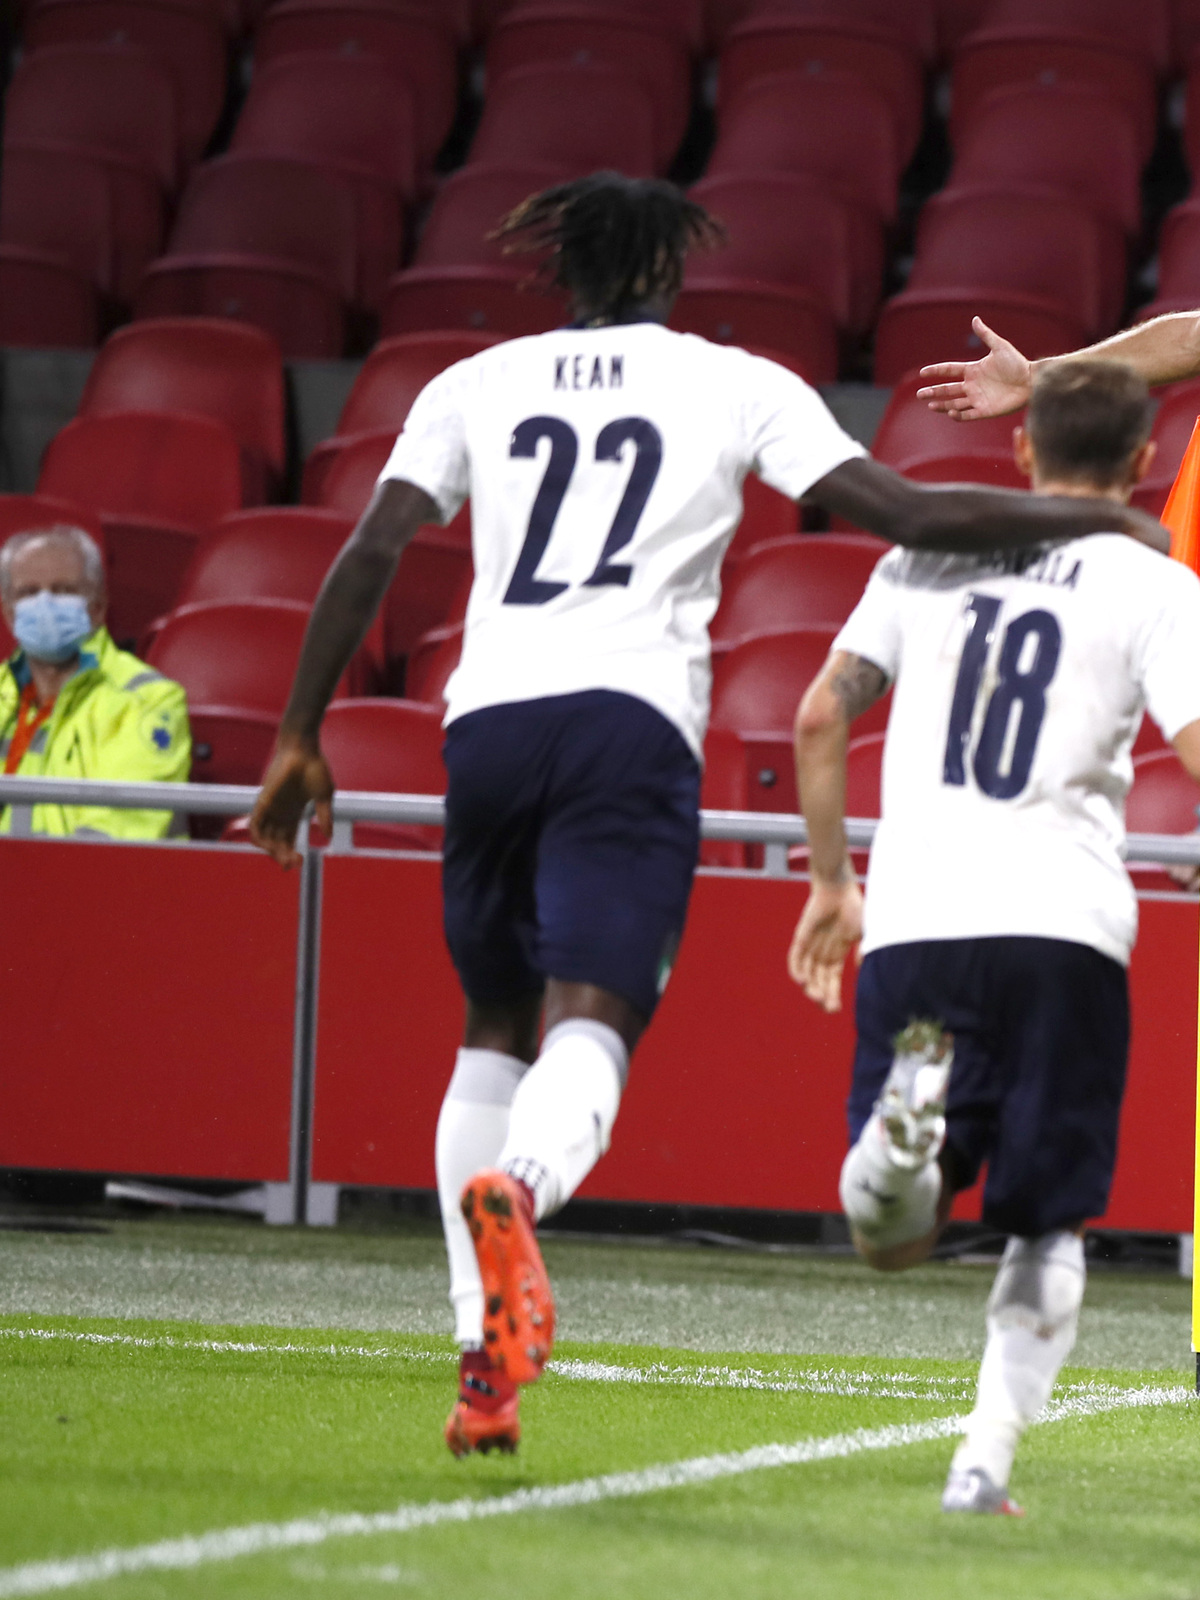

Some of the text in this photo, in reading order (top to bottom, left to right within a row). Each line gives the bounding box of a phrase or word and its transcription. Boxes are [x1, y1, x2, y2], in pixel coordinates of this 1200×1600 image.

[554, 354, 624, 391] KEAN
[502, 414, 664, 606] 22
[942, 591, 1063, 801] 18
